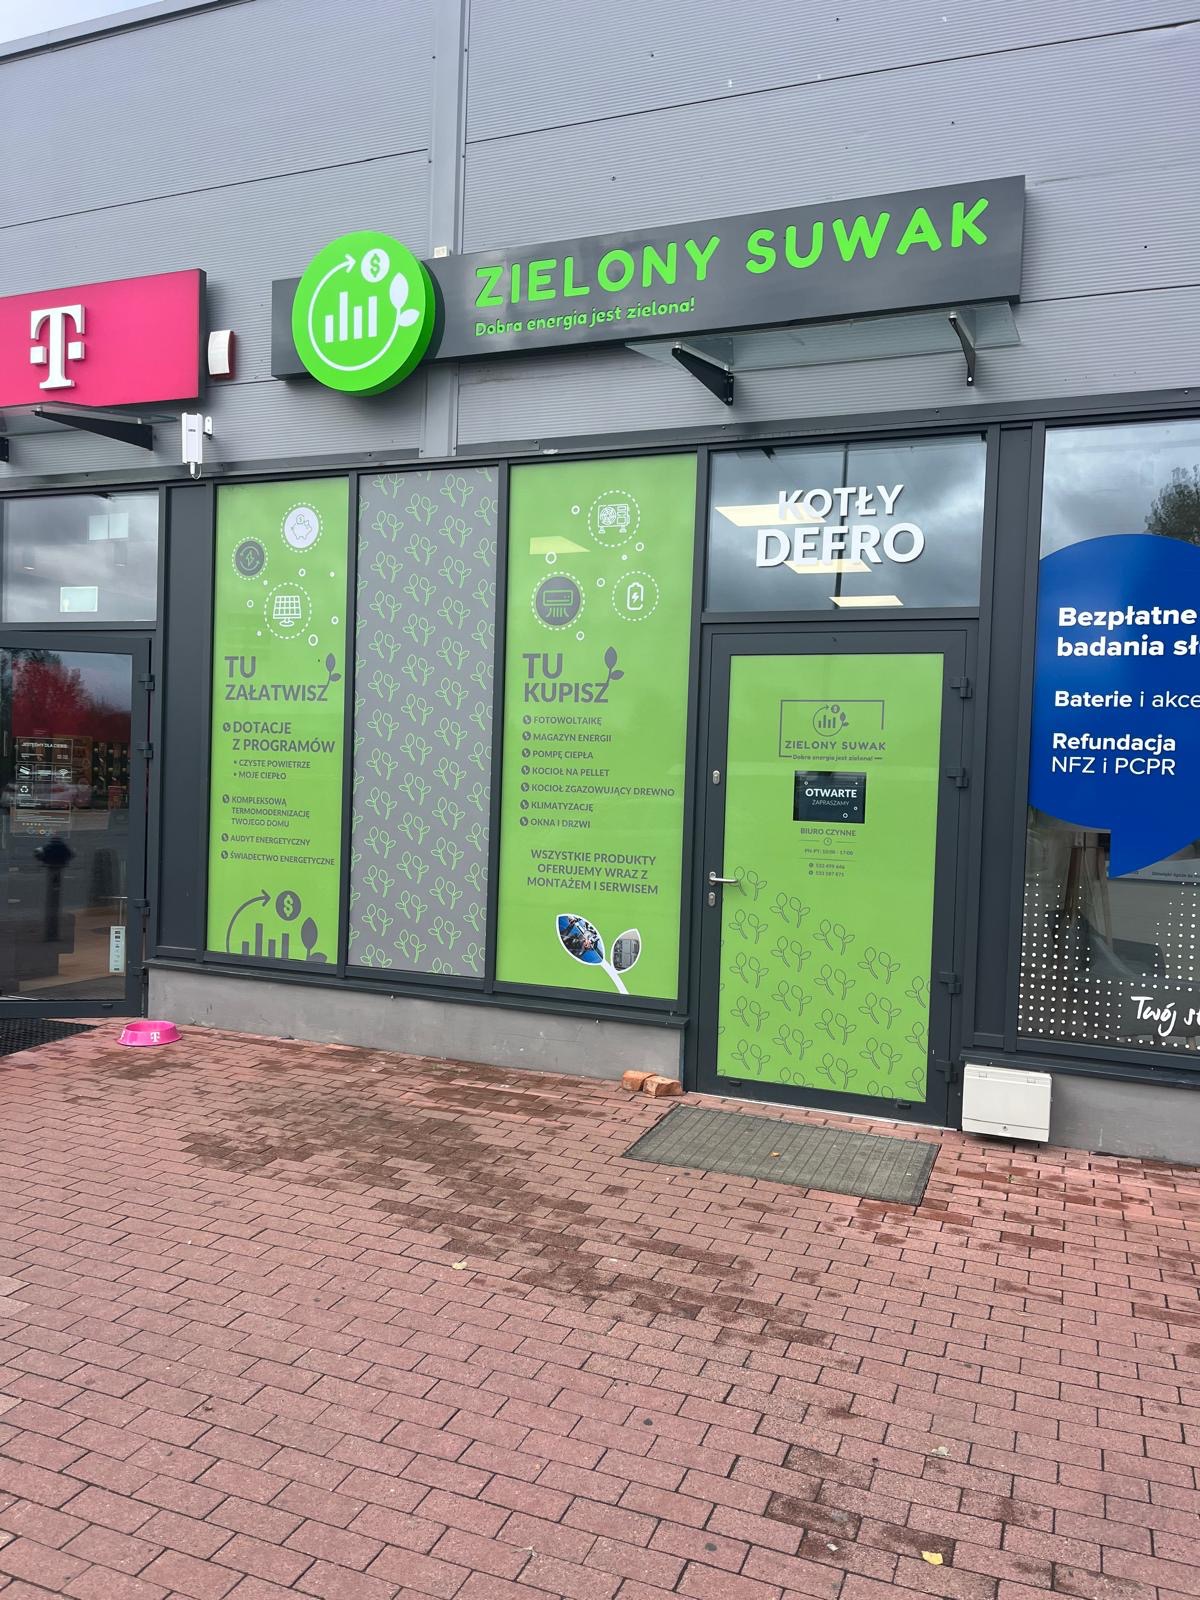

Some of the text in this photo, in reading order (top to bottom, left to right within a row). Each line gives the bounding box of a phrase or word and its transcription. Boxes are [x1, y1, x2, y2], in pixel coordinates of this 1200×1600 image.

[475, 198, 989, 308] ZIELONY SUWAK
[475, 297, 695, 336] Dobra energia jest zielona!
[778, 484, 904, 520] KOTŁY
[756, 522, 925, 567] DEFRO
[1058, 605, 1197, 631] Bezpłatne
[1057, 634, 1200, 656] badania sł
[224, 655, 256, 678] TU
[522, 653, 563, 679] TU
[225, 684, 328, 701] ZAŁATWISZ
[524, 682, 609, 703] KUPISZ
[1055, 690, 1132, 707] Baterie
[1140, 691, 1144, 707] i
[233, 721, 291, 734] DOTACJE
[533, 716, 602, 726] FOTOWOLTAIKĘ
[232, 737, 335, 753] Z PROGRAMÓW
[533, 733, 612, 743] MAGAZYN ENERGII
[785, 740, 886, 751] ZIELONY SUWAK
[1052, 732, 1176, 755] Refundacja
[532, 750, 593, 760] POMPĘ CIEPŁA
[238, 759, 311, 769] CZYSTE POWIETRZE
[1051, 756, 1175, 776] NFZ i PCPR
[238, 771, 287, 780] MOJE CIEPŁO
[532, 767, 610, 777] KOCIOŁ NA PELLET
[531, 784, 675, 797] KOCIOŁ ZGAZOWUJĄCY DREWNO
[805, 788, 857, 798] OTWARTE
[231, 796, 287, 807] KOMPLEKSOWĄ
[531, 801, 593, 812] KLIMATYZACJĘ
[811, 799, 849, 807] ZAPRASZAMY
[232, 807, 310, 819] TERMOMODERNIZACJĘ
[232, 818, 289, 827] TWOJEGO DOMU
[530, 818, 555, 827] OKNA
[562, 819, 591, 828] DRZWI
[800, 827, 857, 837] BIURO CZYNNE
[230, 835, 310, 846] AUDYT ENERGETYCZNY
[229, 850, 335, 865] ŚWIADECTWO ENERGETYCZNE
[530, 849, 656, 865] WSZYSTKIE PRODUKTY
[537, 863, 648, 879] OFERUJEMY WRAZ Z
[527, 876, 591, 890] MONTAŻEM
[599, 881, 658, 895] SERWISEM
[1130, 995, 1177, 1037] Twój
